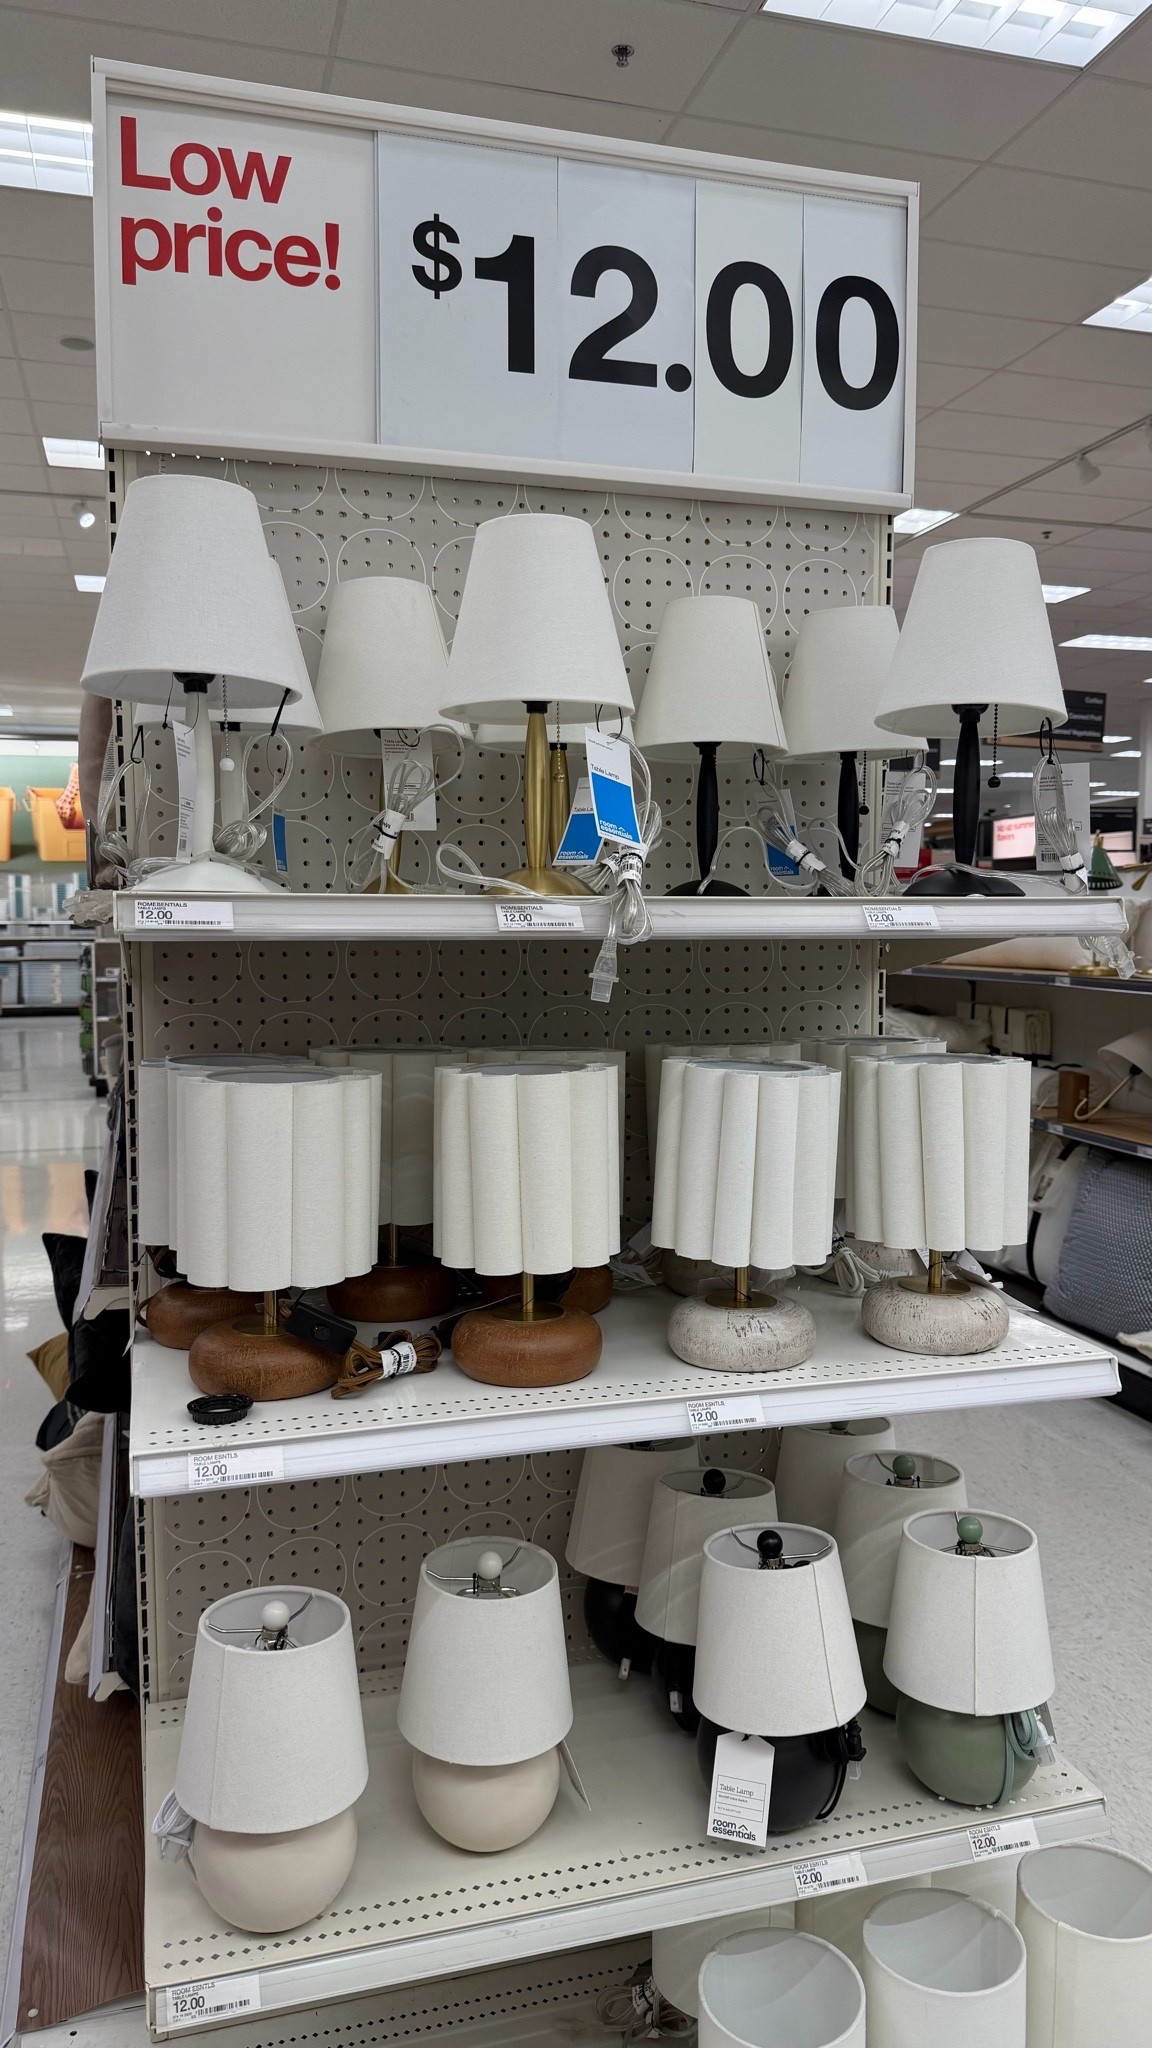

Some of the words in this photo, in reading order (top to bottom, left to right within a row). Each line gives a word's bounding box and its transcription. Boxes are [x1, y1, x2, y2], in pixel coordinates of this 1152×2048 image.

[120, 115, 292, 204] Low
[121, 207, 341, 290] price!
[411, 213, 901, 411] $12.00
[591, 763, 605, 775] Table
[605, 770, 620, 780] Lamp
[600, 819, 617, 831] room
[600, 824, 633, 840] essentials
[139, 910, 173, 920] 12.00
[503, 913, 533, 923] 12.00
[867, 913, 895, 923] 12.00
[690, 1411, 719, 1423] 12.00
[193, 1455, 213, 1463] ROOM
[214, 1452, 239, 1460] ESNTLS
[194, 1464, 228, 1478] 12.00
[719, 1783, 736, 1793] Table
[736, 1786, 755, 1798] Lamp
[712, 1818, 737, 1830] room
[712, 1825, 757, 1841] essentials
[972, 1836, 997, 1851] 12.00
[793, 1863, 809, 1871] ROOM
[796, 1871, 823, 1886] 12.00
[171, 1986, 191, 1997] ROOM
[191, 1981, 216, 1992] ESNTLS
[173, 1995, 206, 2014] 12.00
